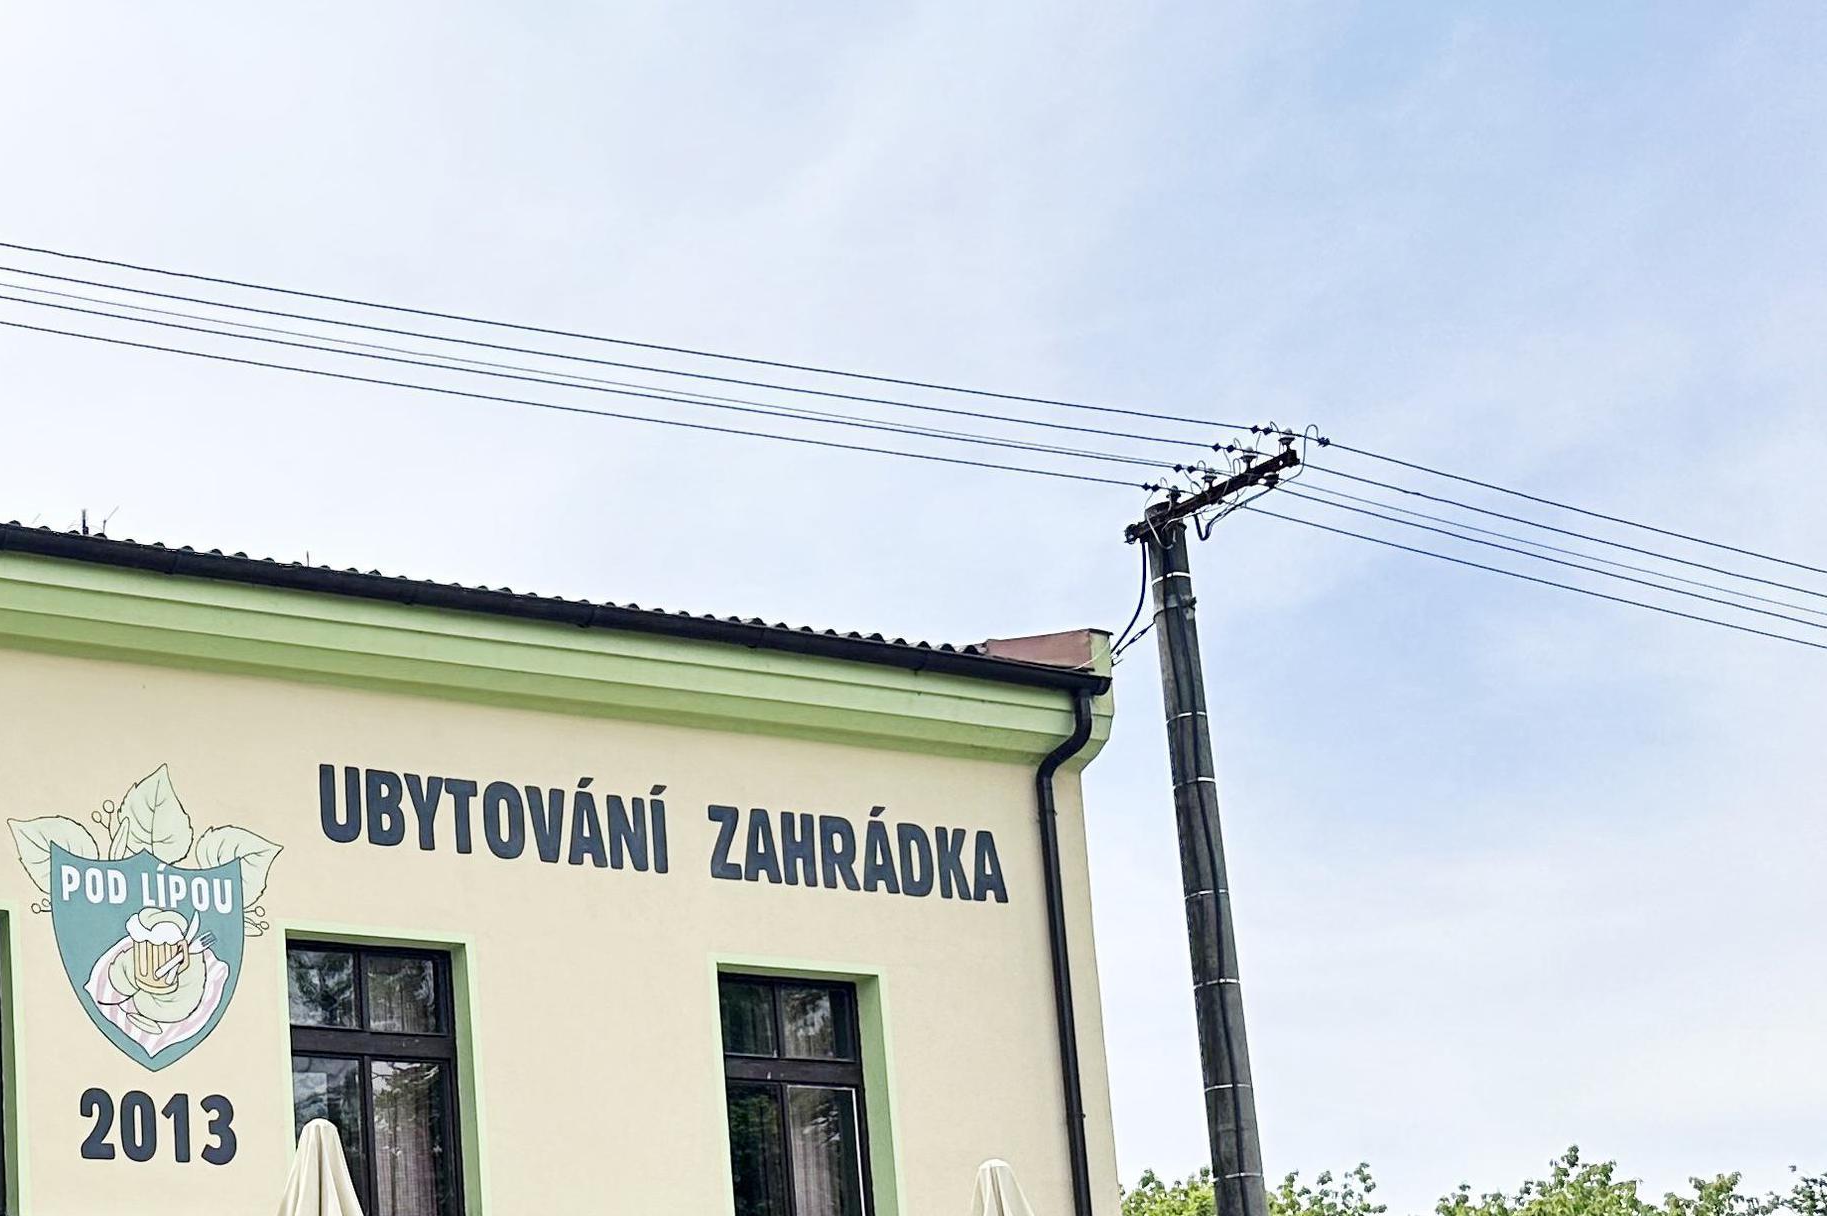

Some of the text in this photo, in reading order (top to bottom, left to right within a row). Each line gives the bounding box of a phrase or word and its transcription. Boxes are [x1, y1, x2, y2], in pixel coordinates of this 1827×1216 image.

[319, 763, 1009, 904] UBYTOVÁNÍ ZAHRÁDKA
[61, 863, 233, 914] POD LÍPOU
[79, 1087, 237, 1166] 2013
